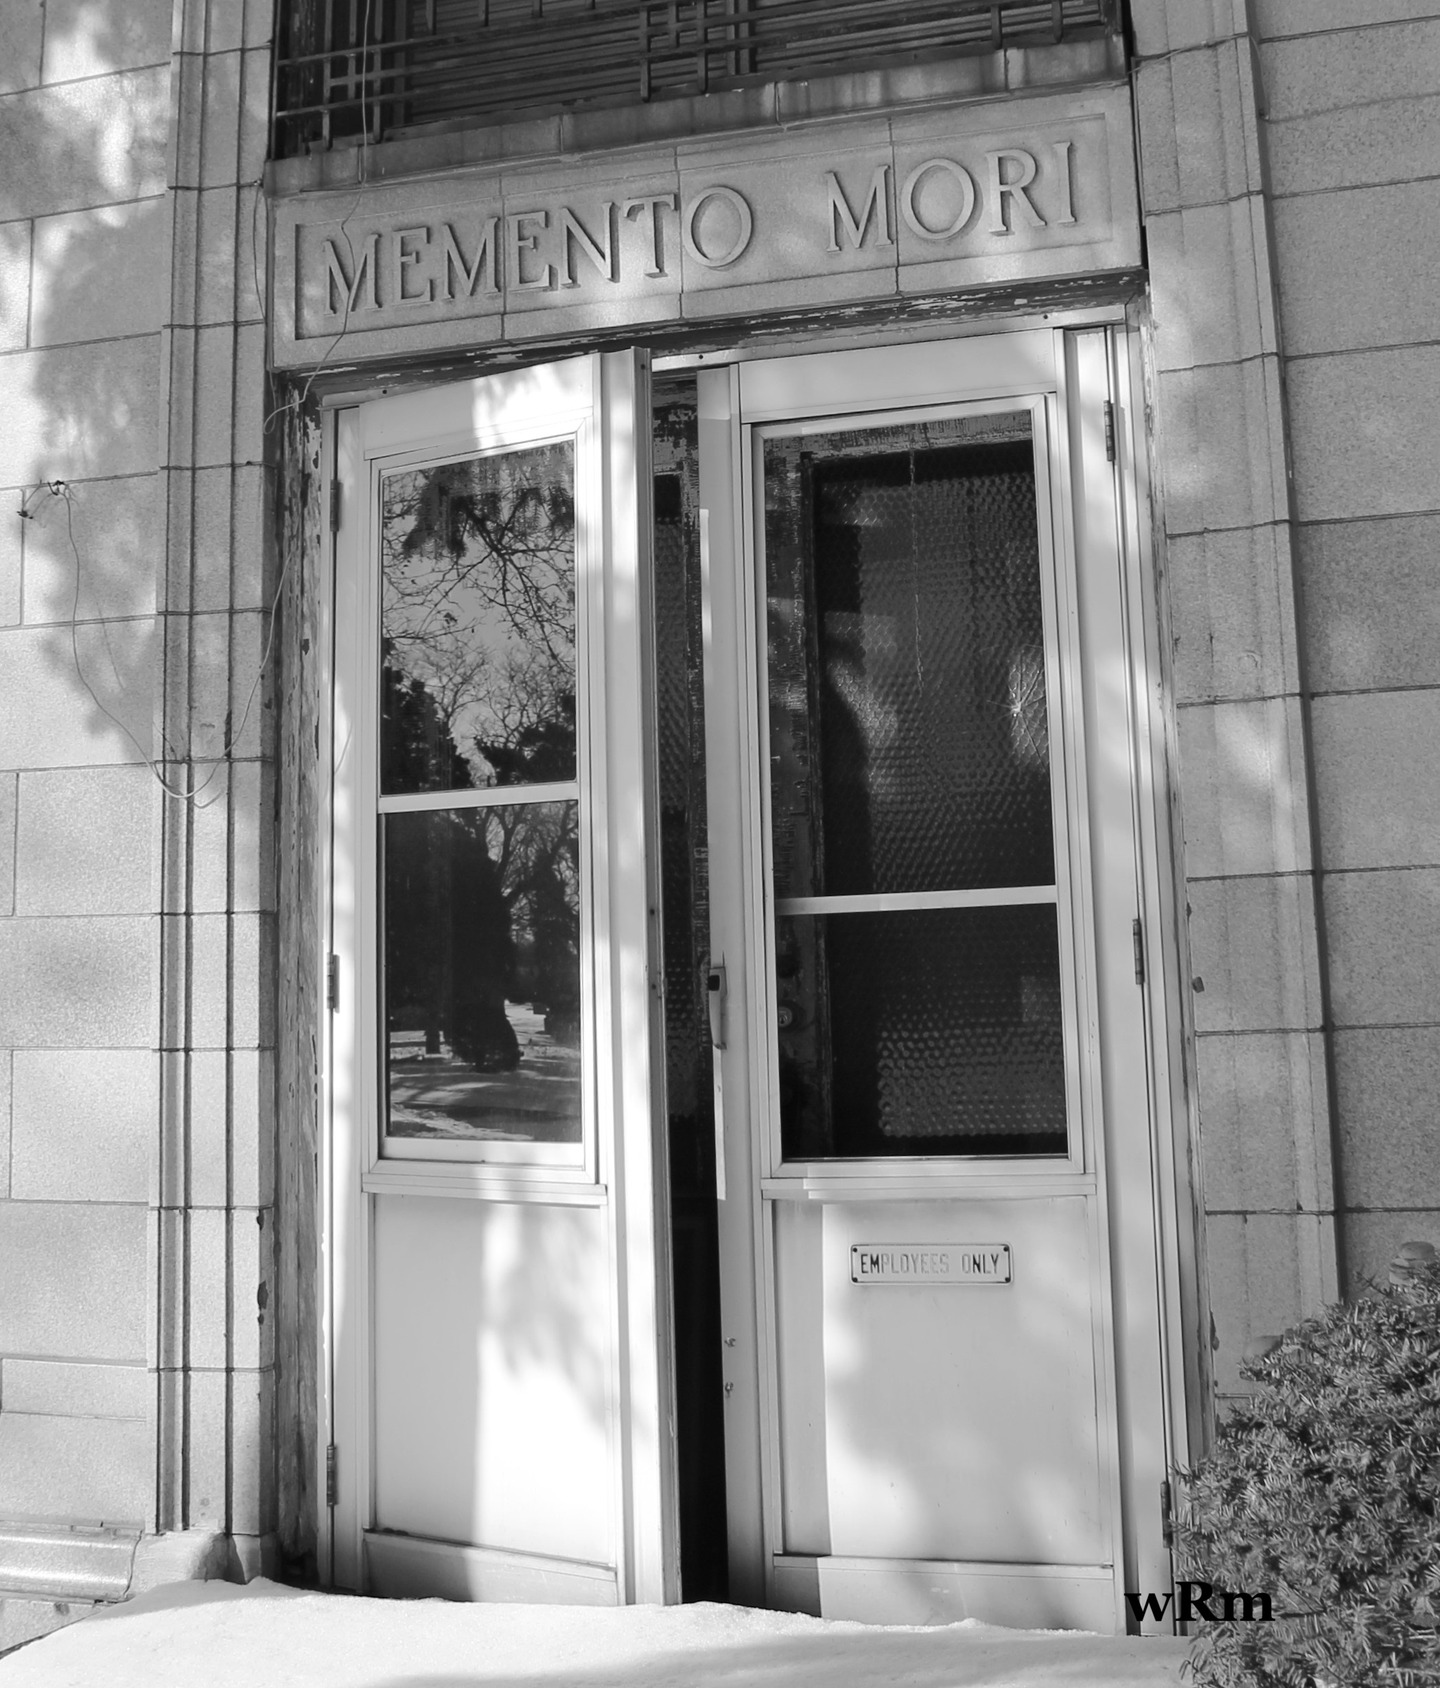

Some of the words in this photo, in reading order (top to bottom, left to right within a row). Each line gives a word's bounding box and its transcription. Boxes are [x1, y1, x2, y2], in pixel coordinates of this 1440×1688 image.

[322, 185, 754, 314] MEMENTO
[825, 141, 1078, 253] MORI
[860, 1253, 950, 1274] EMPLOYEES
[961, 1253, 999, 1274] ONLY
